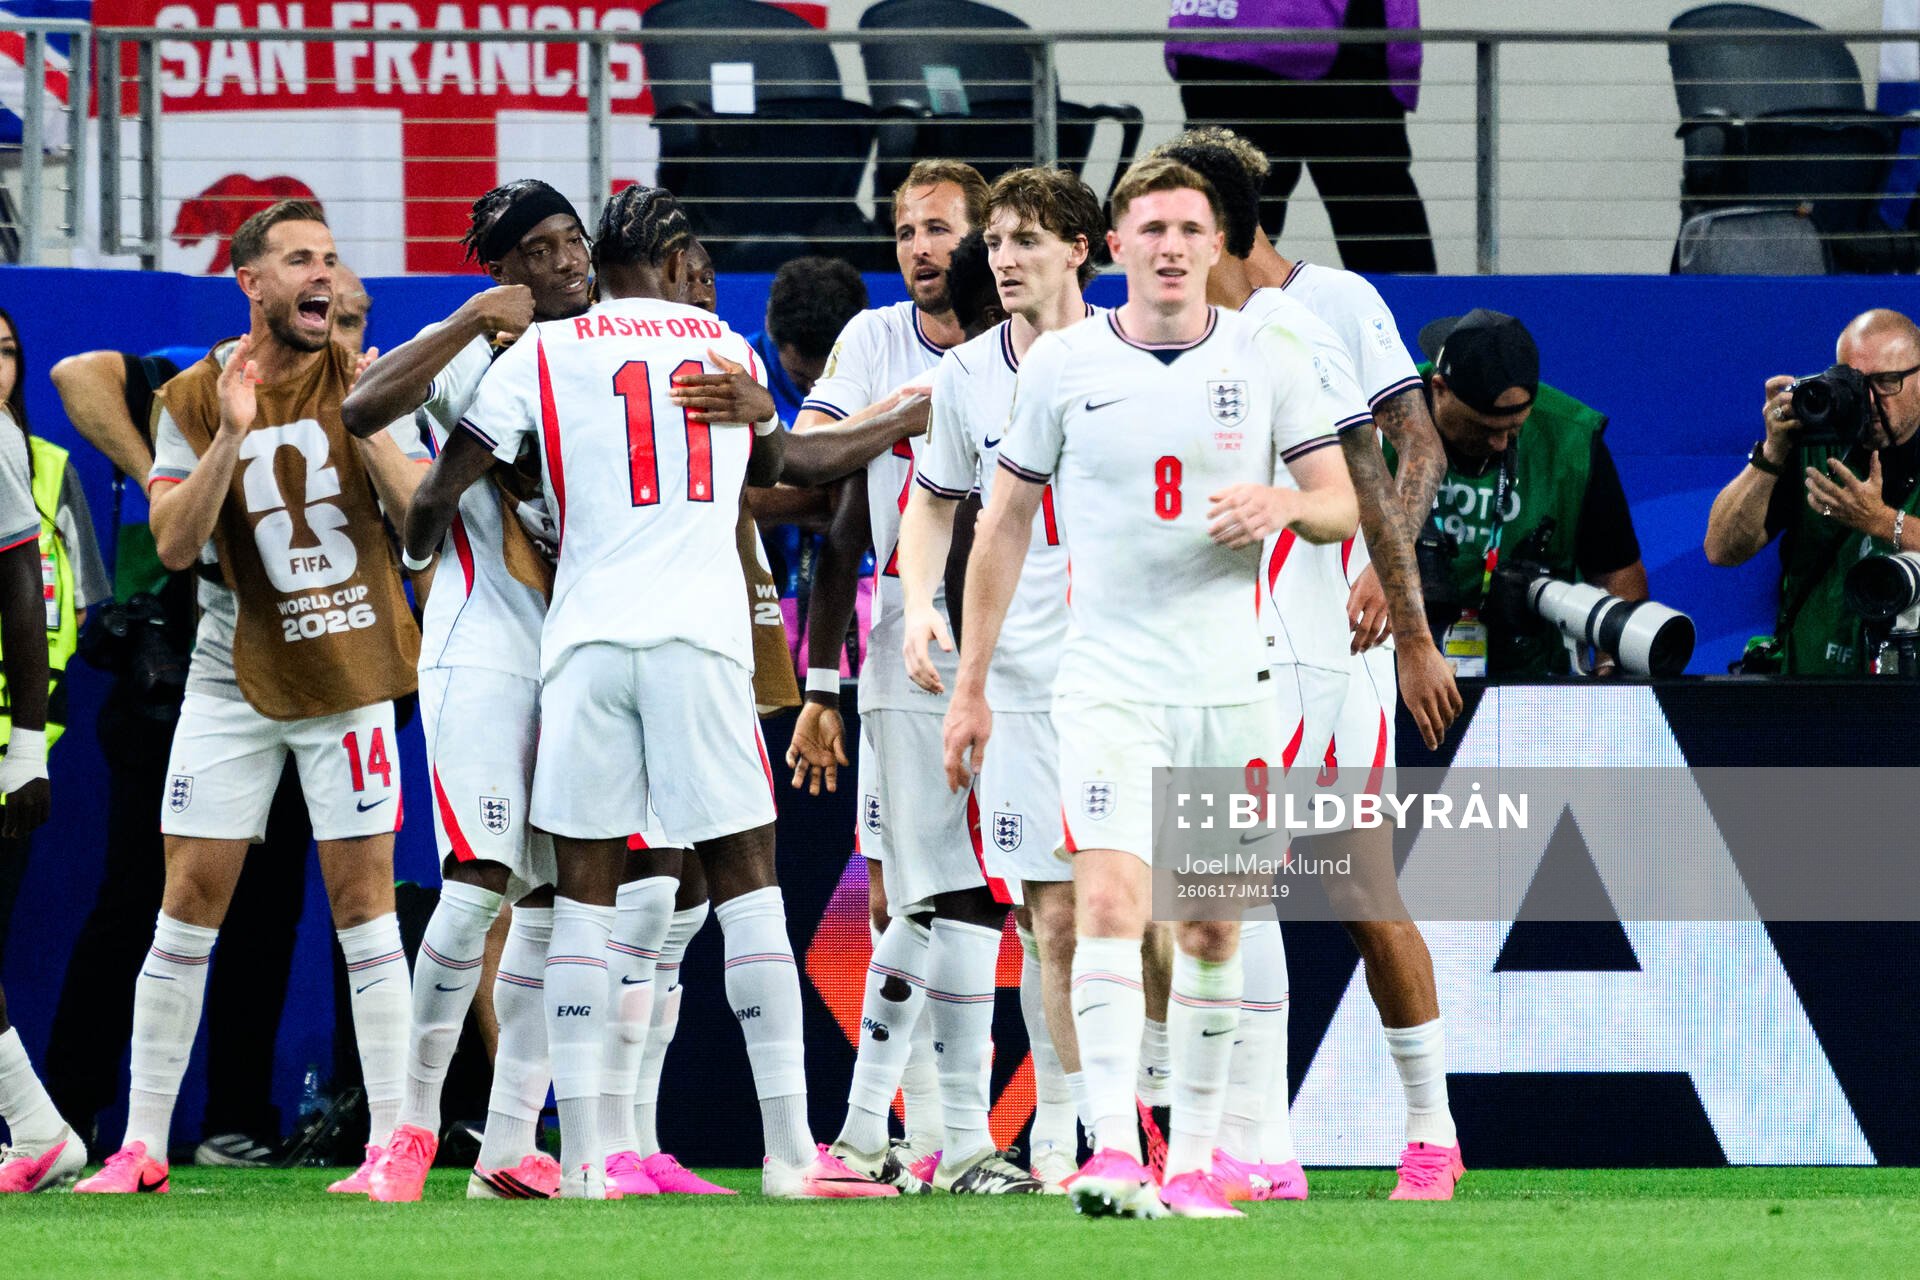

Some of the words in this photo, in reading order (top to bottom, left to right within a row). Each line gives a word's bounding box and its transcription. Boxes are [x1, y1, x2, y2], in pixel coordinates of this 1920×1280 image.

[155, 3, 308, 98] SAN
[332, 2, 645, 99] FRANCIS
[574, 314, 723, 340] RASHFORD
[612, 359, 714, 507] 11
[1155, 455, 1182, 521] 8
[289, 554, 332, 575] FIFA
[277, 595, 331, 616] WORLD
[332, 585, 369, 606] CUP
[281, 603, 377, 642] 2026
[1825, 643, 1854, 664] FIF
[342, 727, 391, 792] 14
[1287, 686, 1877, 1166] A
[557, 1005, 591, 1017] ENG
[736, 1006, 761, 1020] ENG
